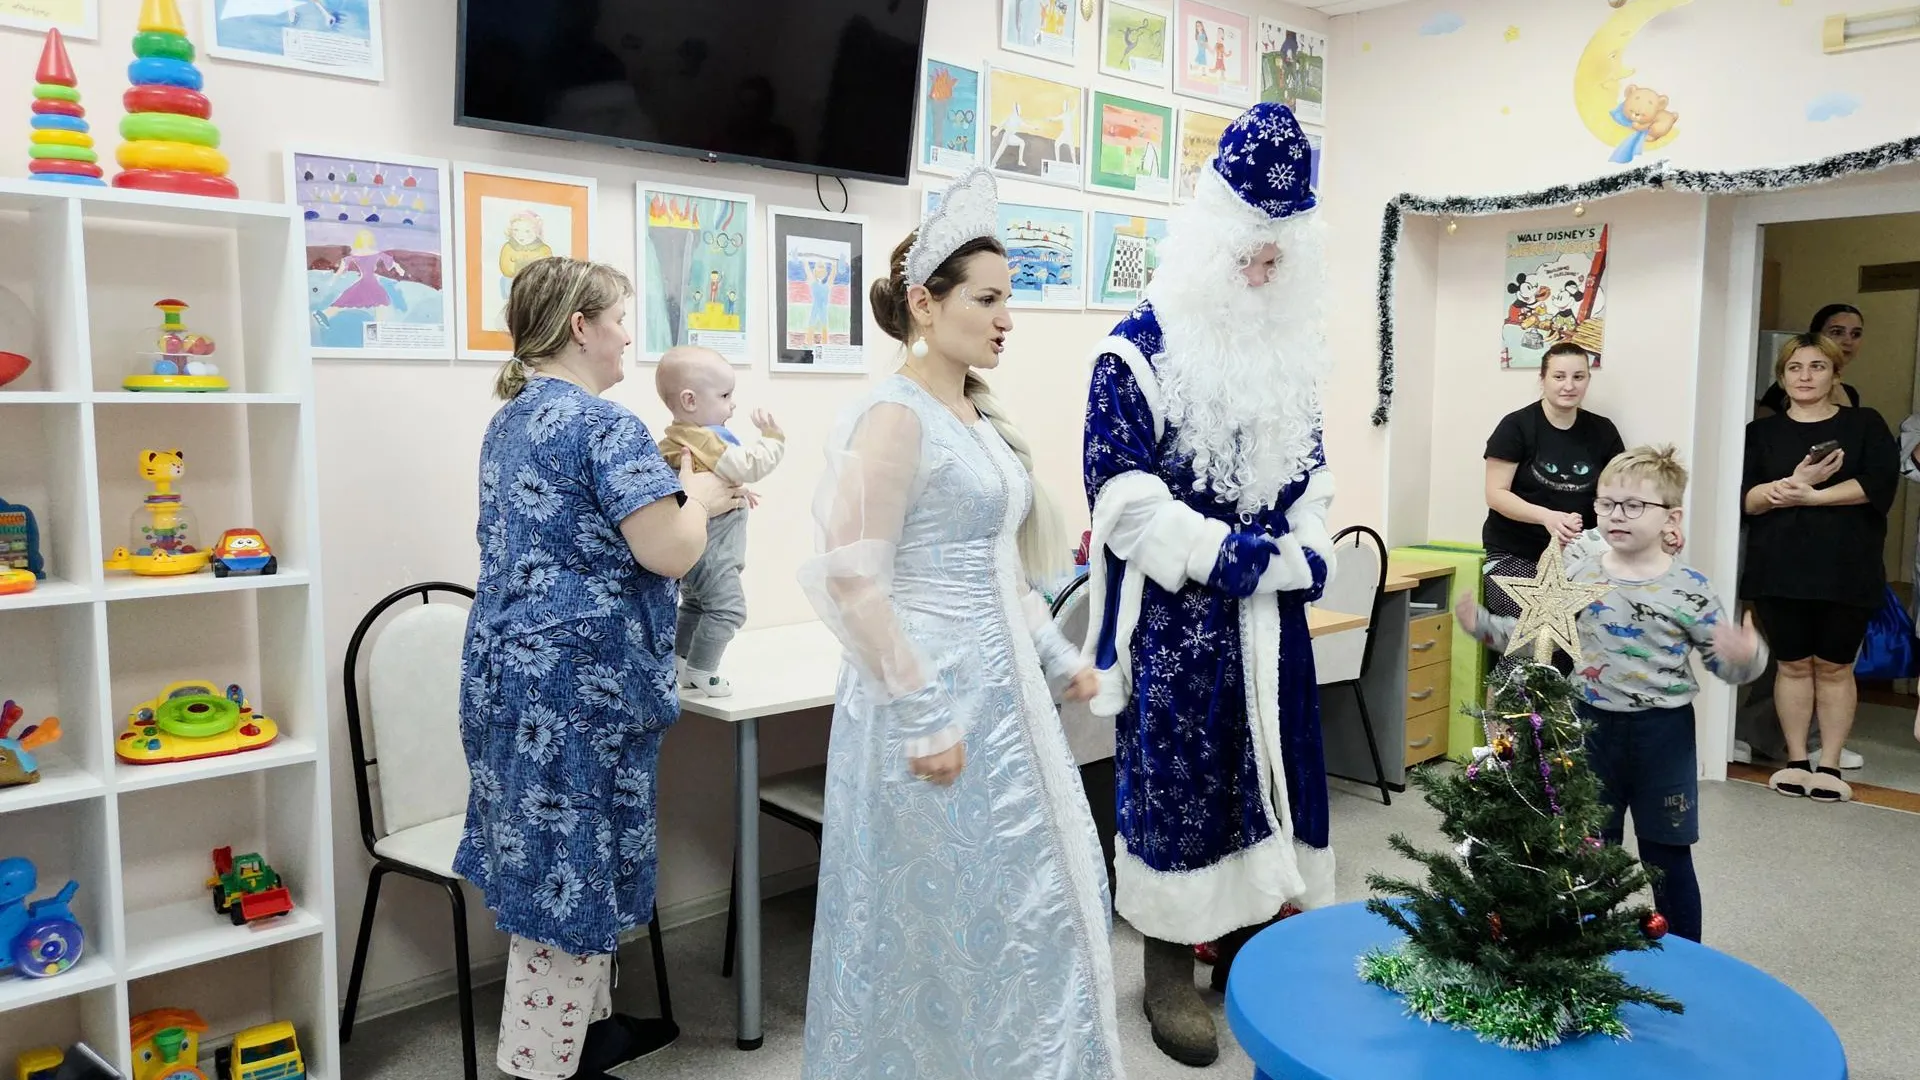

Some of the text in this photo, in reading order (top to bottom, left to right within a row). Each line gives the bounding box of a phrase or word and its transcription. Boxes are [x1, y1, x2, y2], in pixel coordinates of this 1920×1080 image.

[1517, 228, 1595, 242] WALT DISNEY'S
[1664, 793, 1684, 806] HEY
